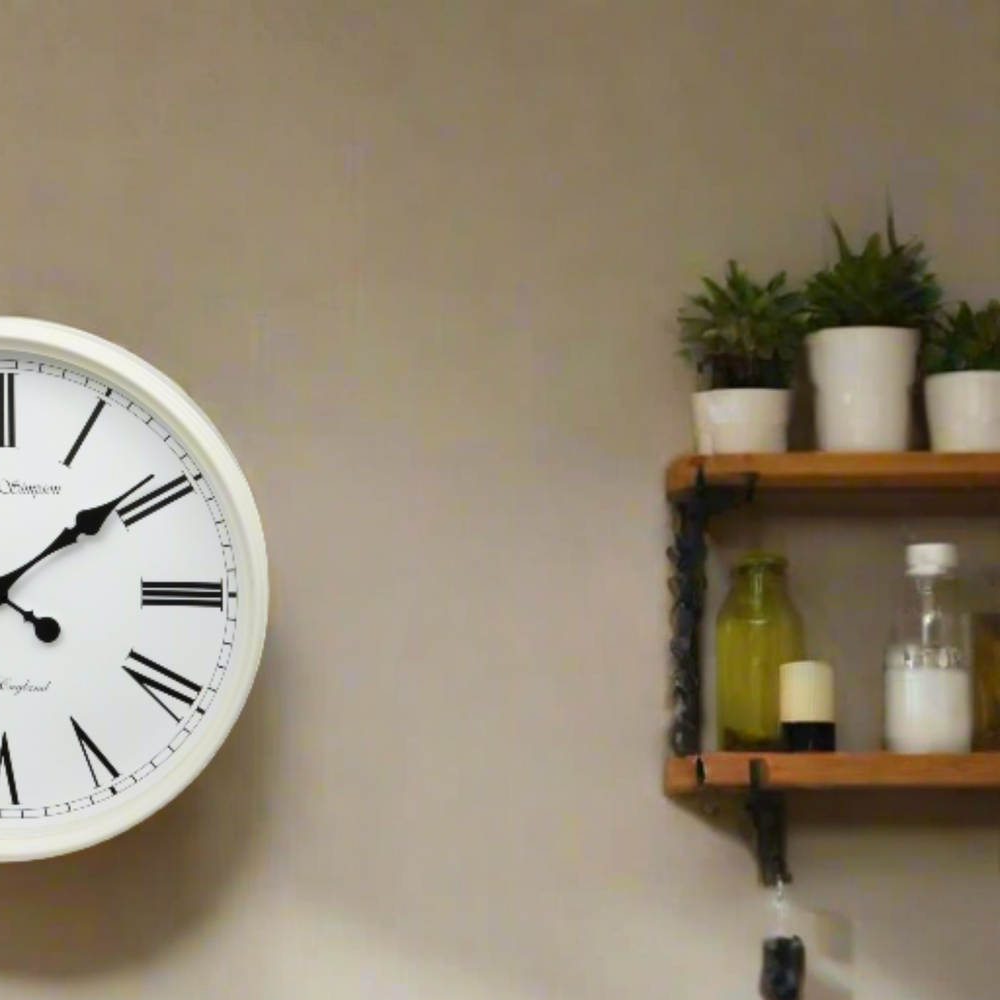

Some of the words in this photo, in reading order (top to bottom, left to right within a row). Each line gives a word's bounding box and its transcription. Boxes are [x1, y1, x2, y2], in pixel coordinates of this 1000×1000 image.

[60, 397, 111, 468] I
[115, 471, 196, 531] II
[141, 577, 223, 611] III
[69, 716, 121, 789] V
